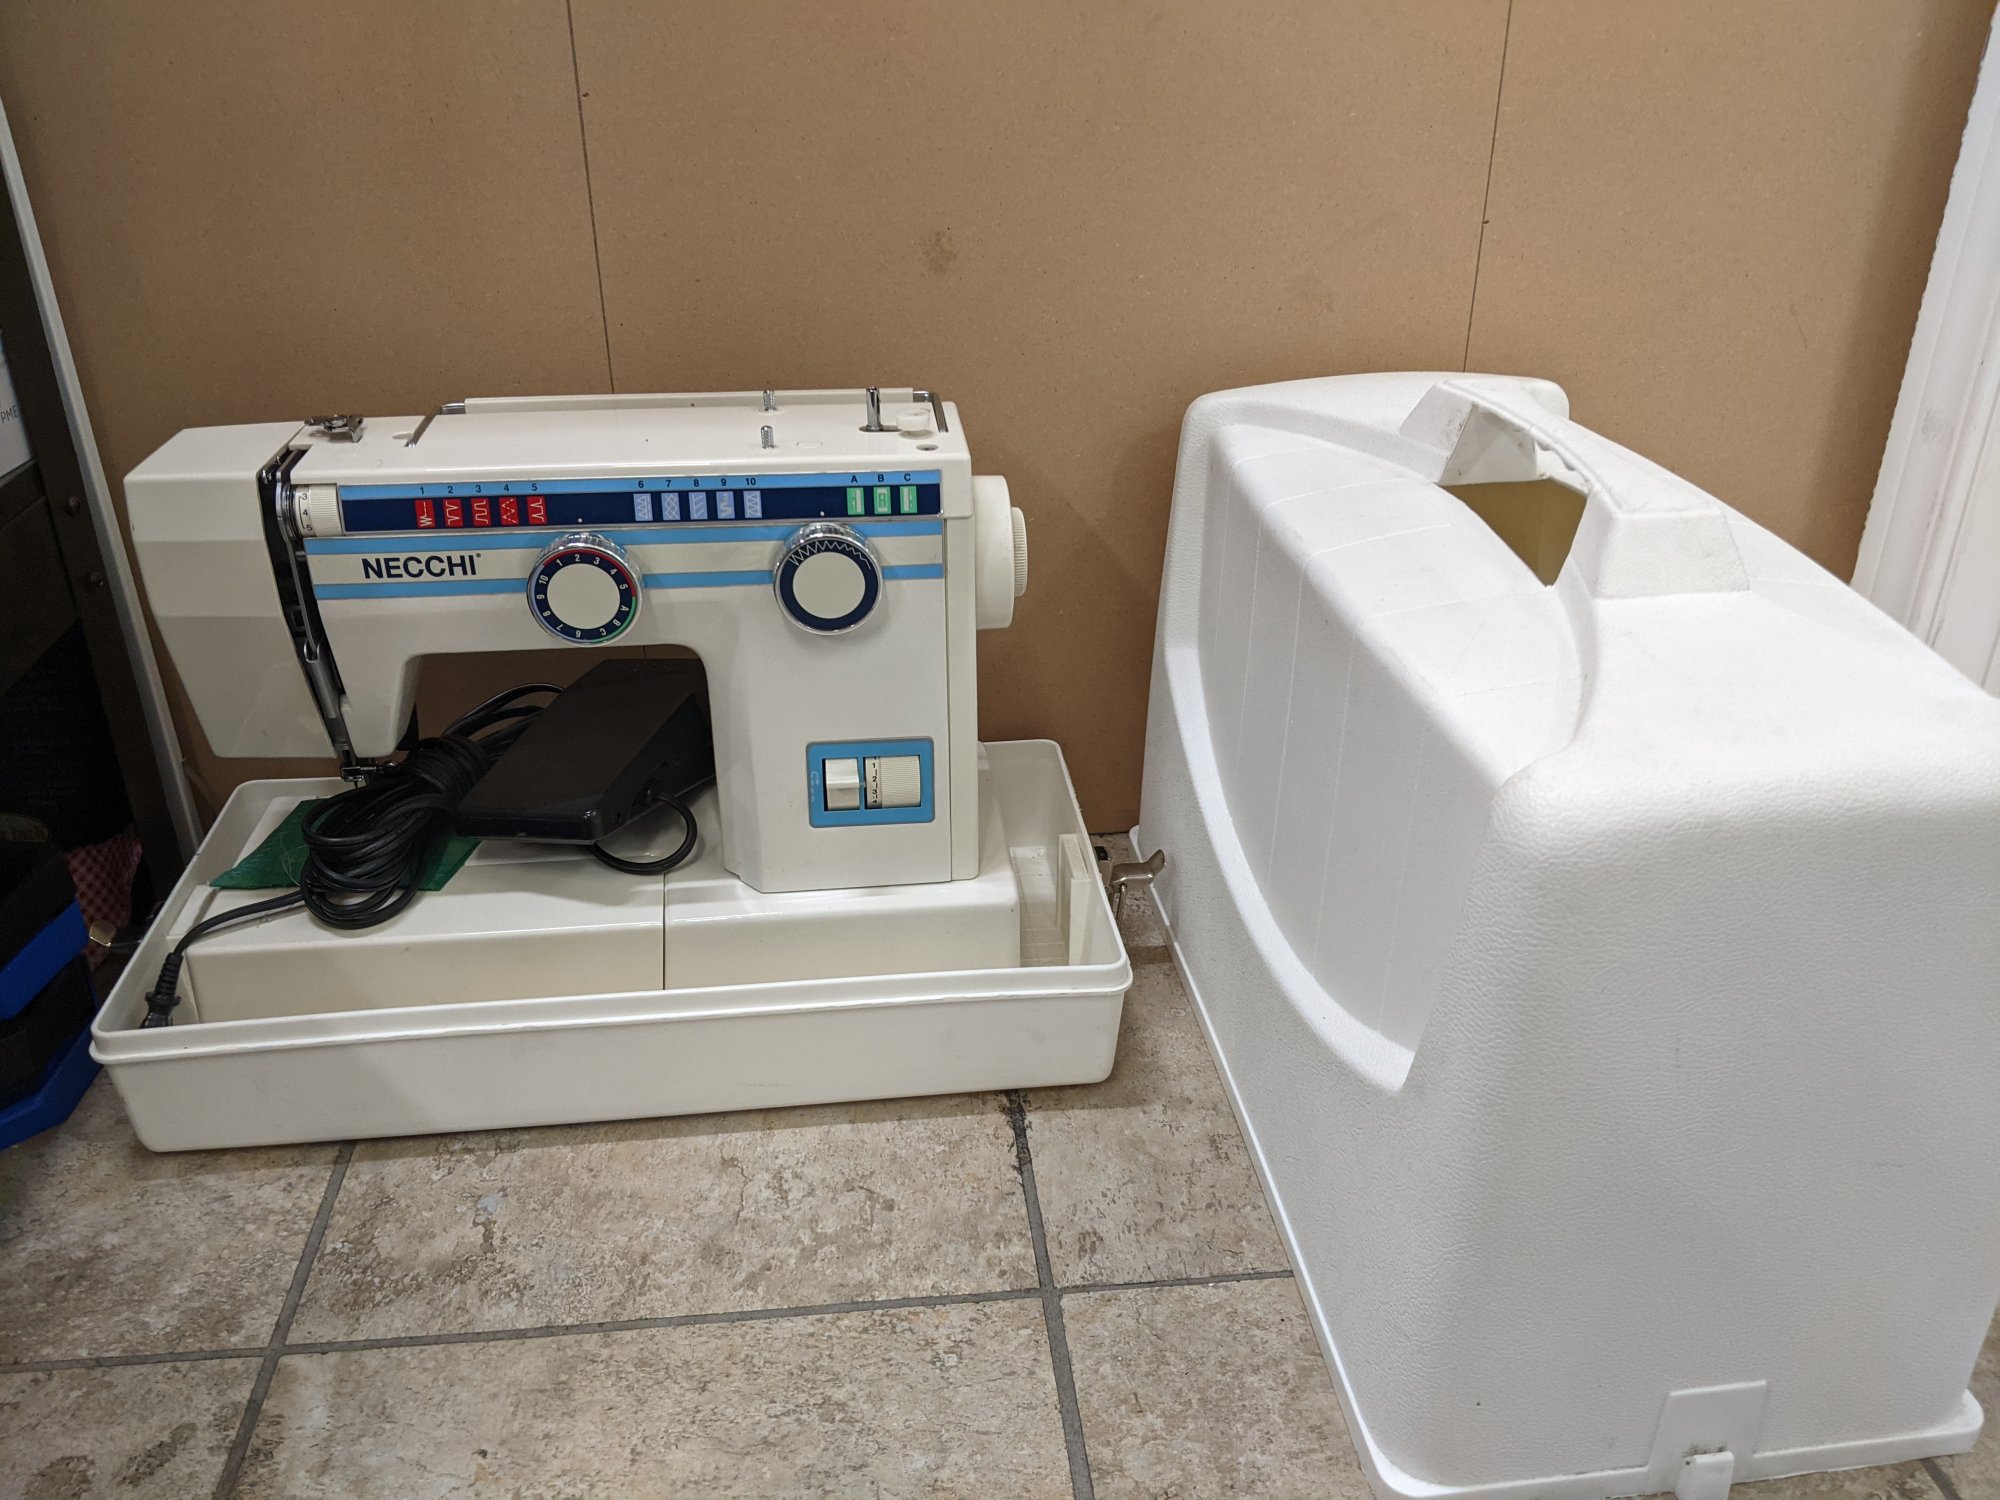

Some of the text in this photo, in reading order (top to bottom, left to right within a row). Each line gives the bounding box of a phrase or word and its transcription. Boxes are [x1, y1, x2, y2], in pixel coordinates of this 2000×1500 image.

[850, 473, 912, 484] A B C
[420, 477, 757, 495] 1 2 3 4 5 6 7 8 9 10
[301, 492, 308, 501] 3
[302, 508, 309, 517] 4
[306, 524, 313, 532] 5
[574, 553, 581, 562] 2
[593, 556, 600, 565] 3
[361, 554, 476, 580] NECCHI
[555, 559, 563, 567] 1
[609, 567, 618, 576] 4
[538, 575, 549, 585] 10
[612, 618, 622, 627] B
[556, 624, 562, 632] 7
[599, 627, 607, 636] C
